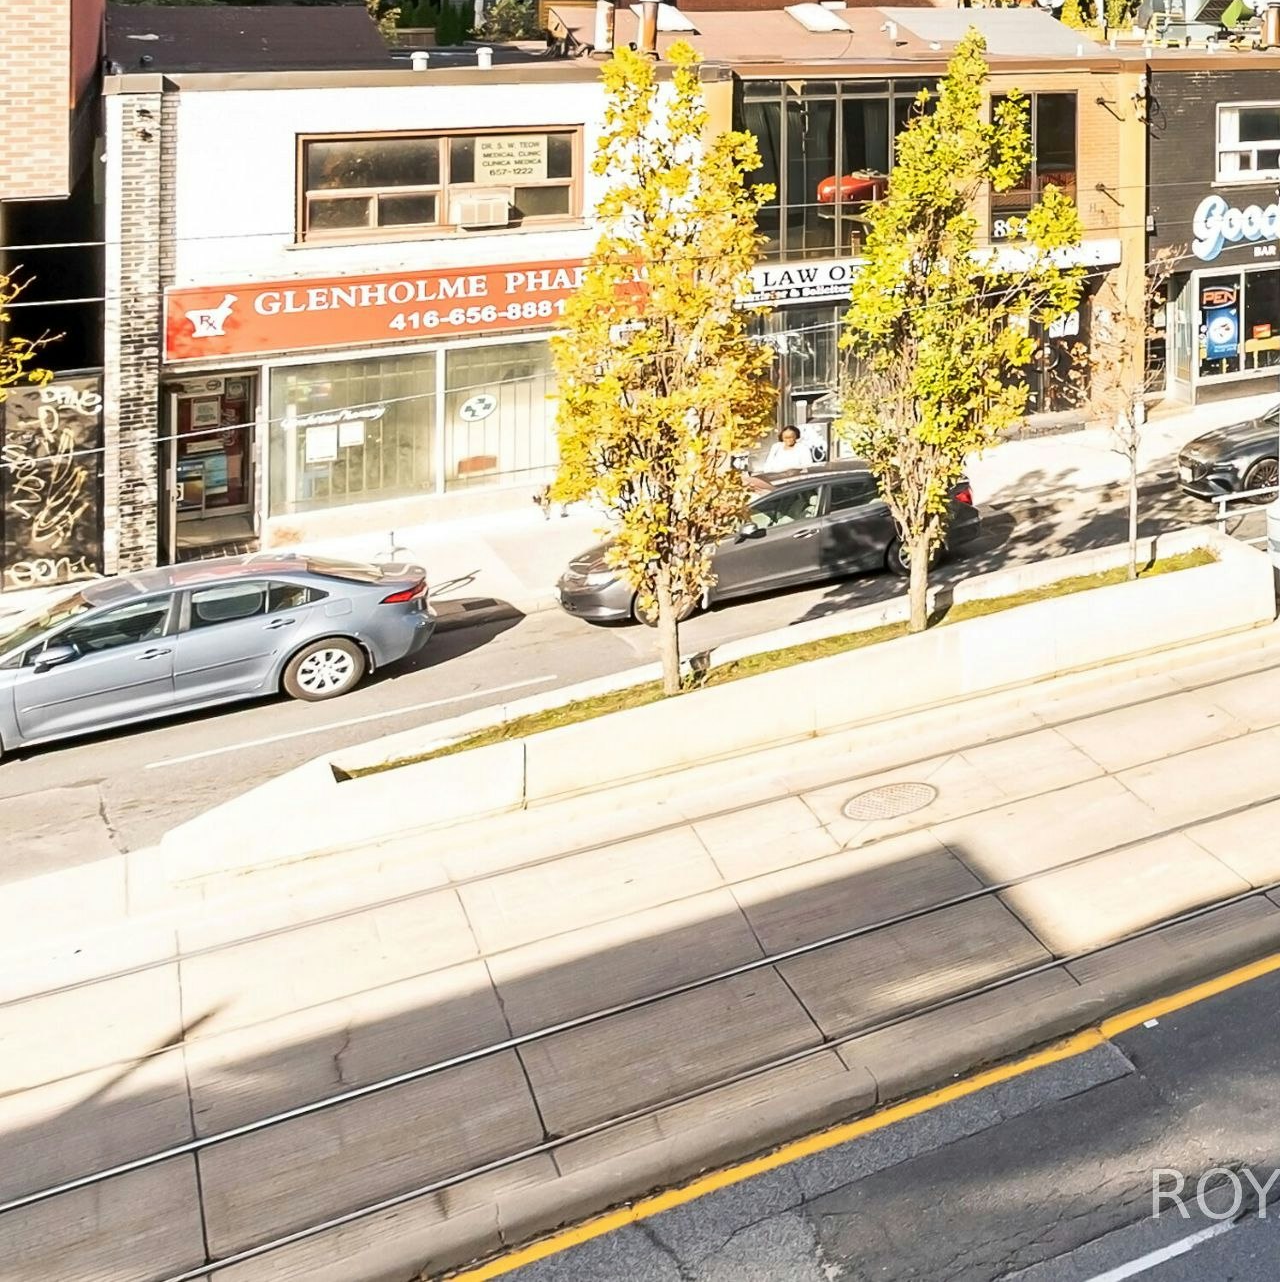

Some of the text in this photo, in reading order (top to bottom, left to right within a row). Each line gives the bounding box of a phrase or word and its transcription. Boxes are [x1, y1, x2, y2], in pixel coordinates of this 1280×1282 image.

[489, 167, 534, 176] 657-1222
[1253, 244, 1276, 258] BAR
[763, 267, 819, 287] LAW
[253, 274, 488, 315] GLENHOLME
